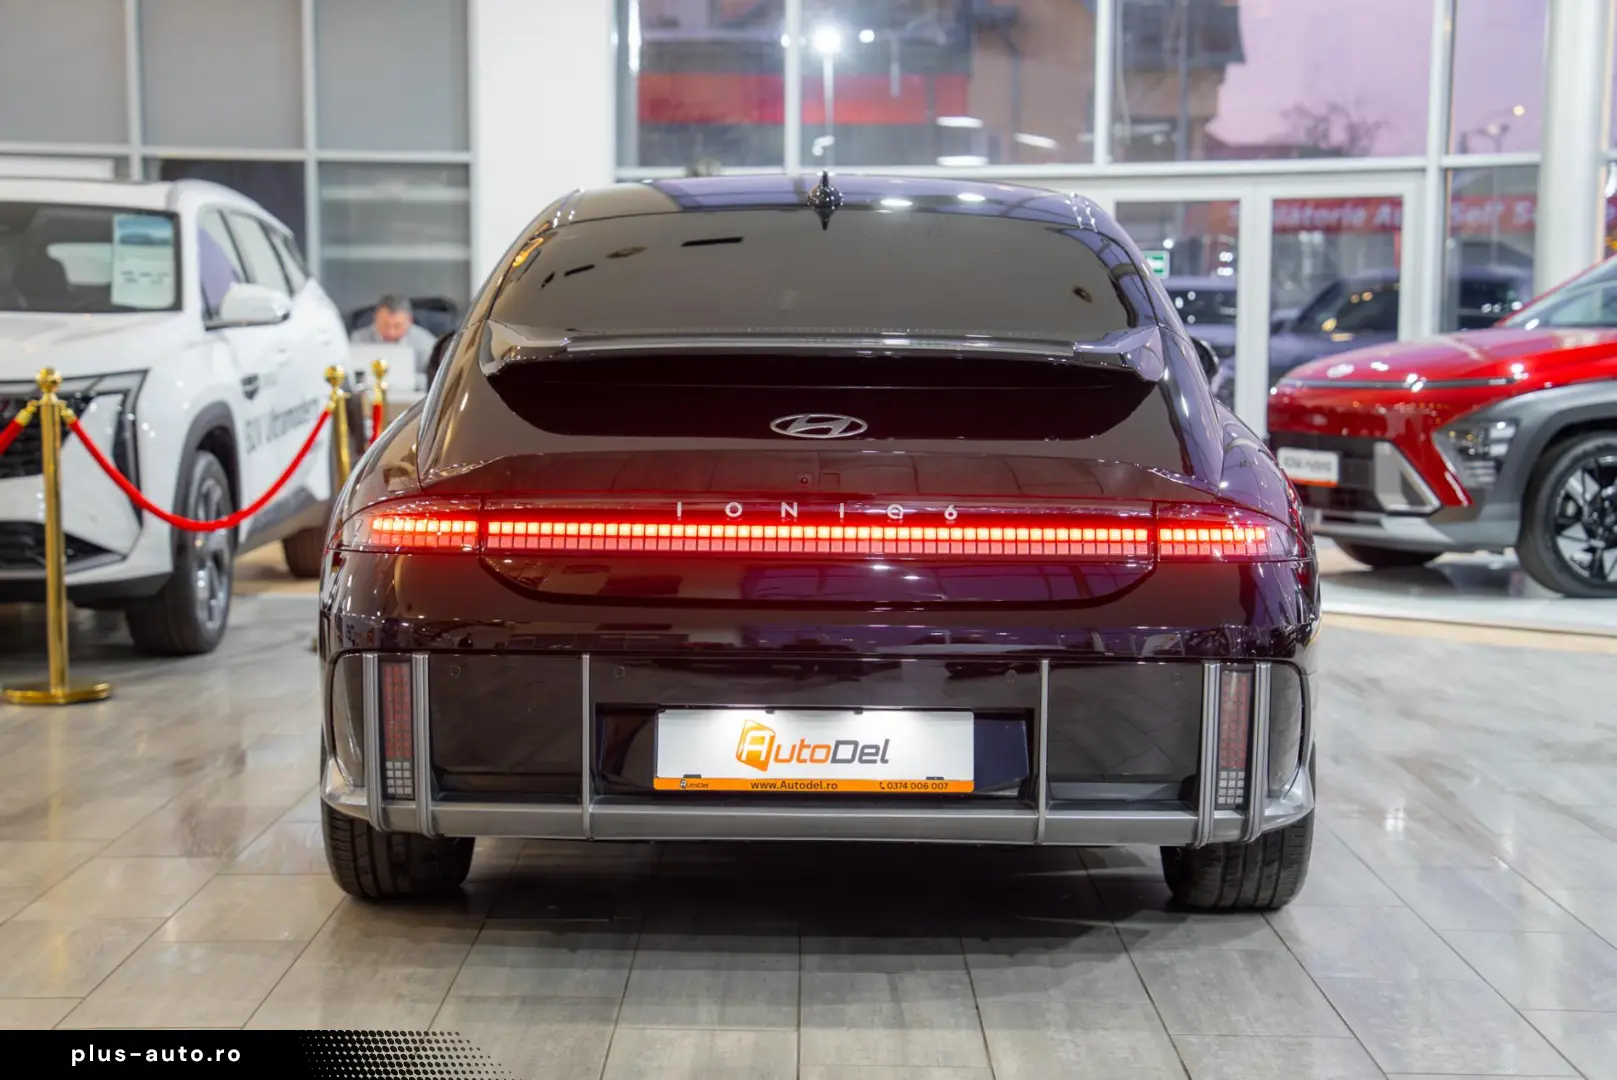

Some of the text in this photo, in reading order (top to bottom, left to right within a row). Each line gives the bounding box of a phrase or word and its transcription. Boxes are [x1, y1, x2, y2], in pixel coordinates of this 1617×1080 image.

[738, 724, 890, 768] AutoDel
[750, 780, 838, 790] www.Autodel.ro
[887, 782, 949, 790] 0374 006 007
